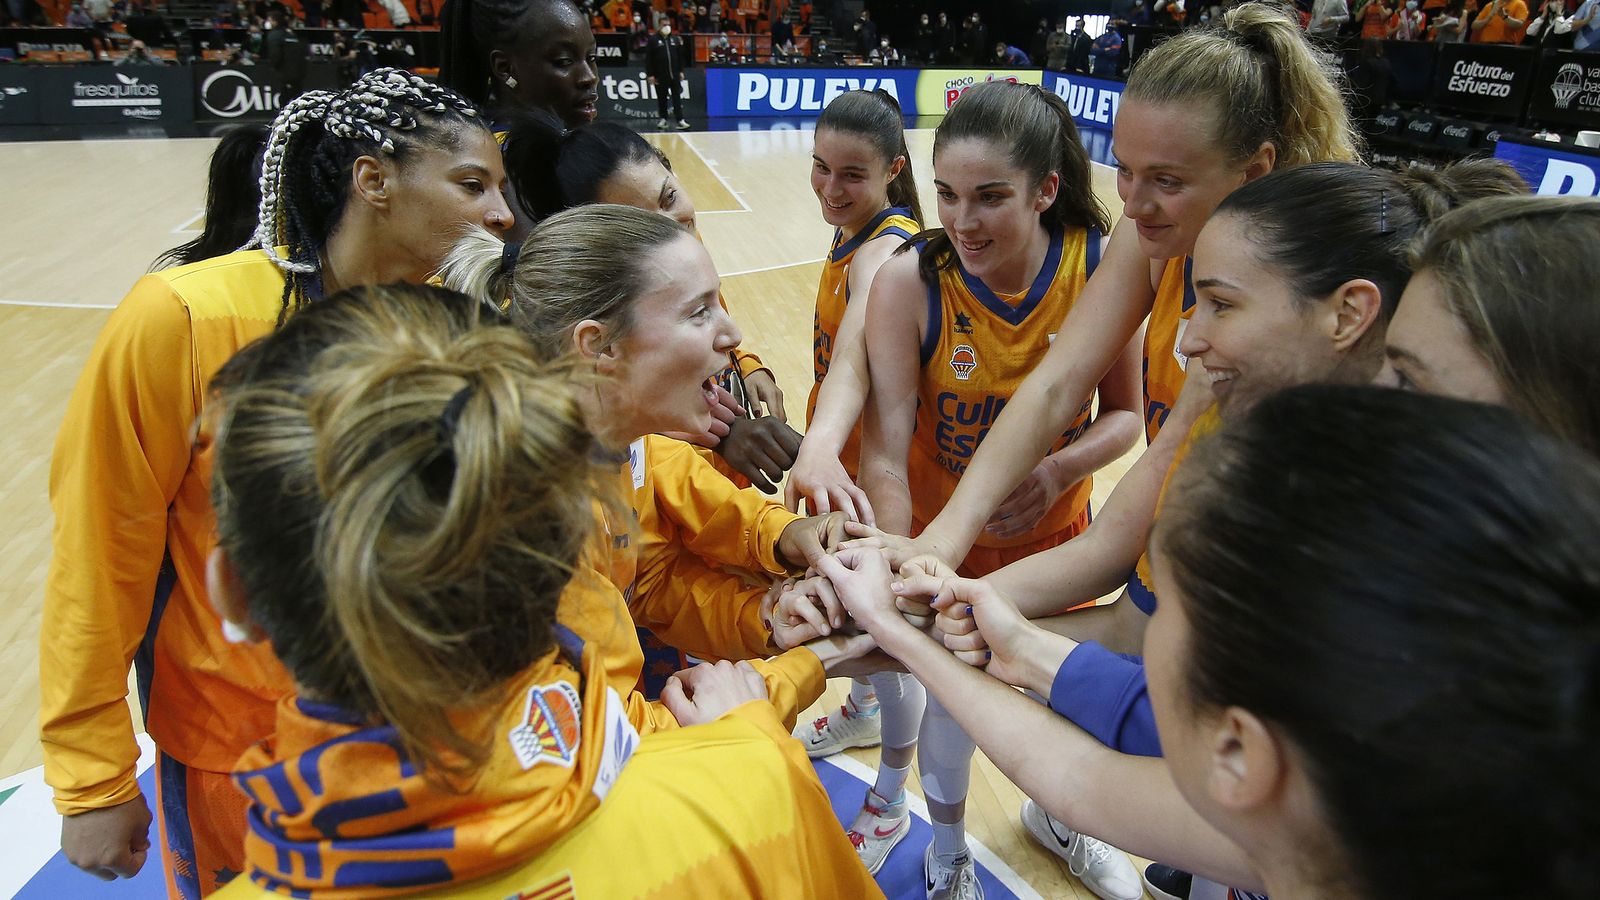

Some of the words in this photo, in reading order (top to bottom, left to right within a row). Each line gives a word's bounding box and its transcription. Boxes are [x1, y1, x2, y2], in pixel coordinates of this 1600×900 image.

[1453, 60, 1502, 79] Cultura
[1500, 71, 1515, 81] del
[73, 81, 159, 98] fresquitos
[945, 76, 974, 89] CHOCO
[1448, 76, 1511, 97] Esfuerzo
